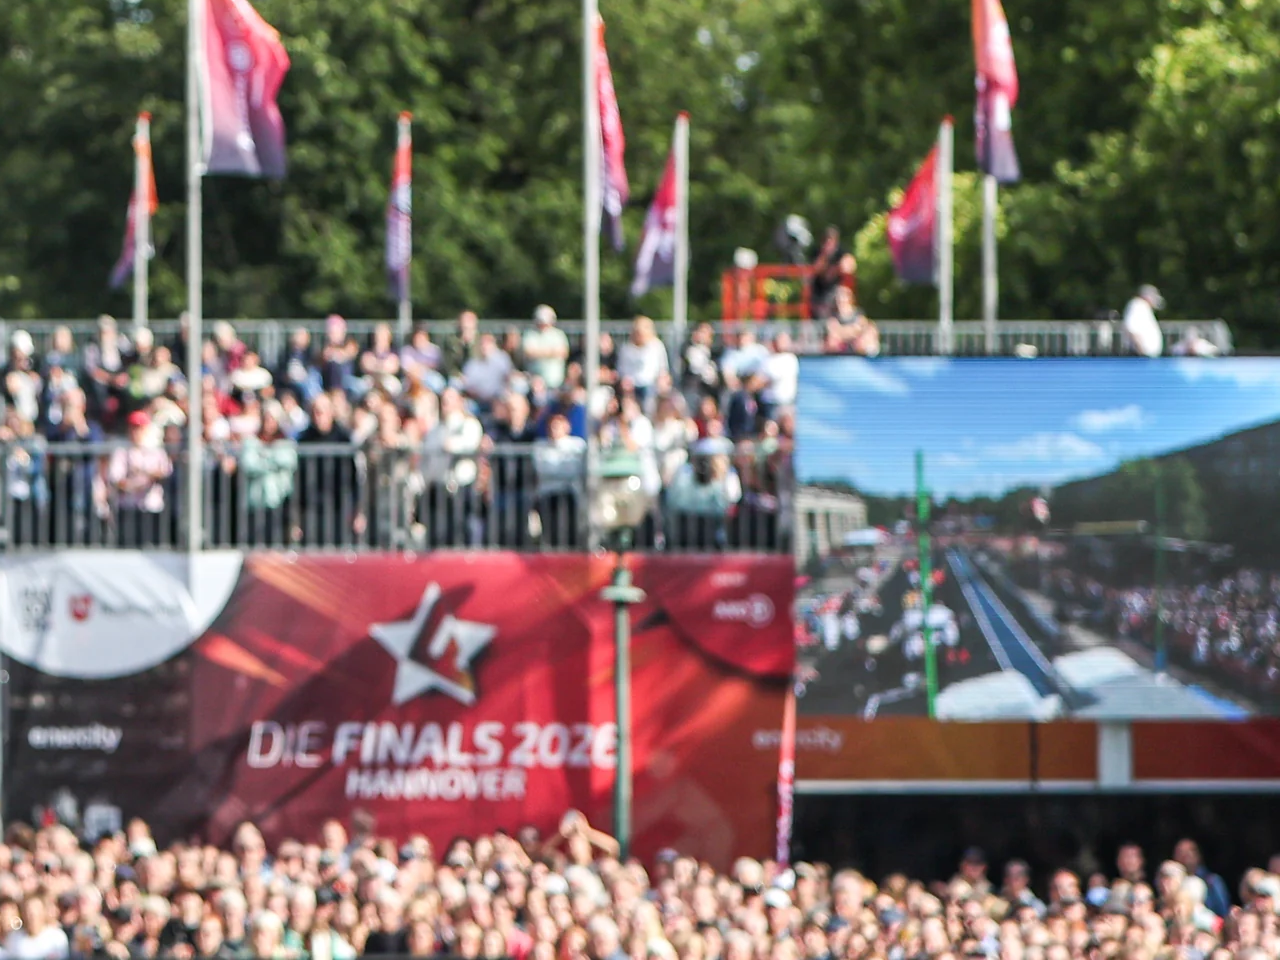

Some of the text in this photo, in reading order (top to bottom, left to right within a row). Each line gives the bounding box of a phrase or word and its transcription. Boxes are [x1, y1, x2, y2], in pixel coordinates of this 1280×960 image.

[246, 720, 326, 769] DIE
[331, 720, 505, 768] FINALS
[344, 768, 528, 802] HANNOVER
